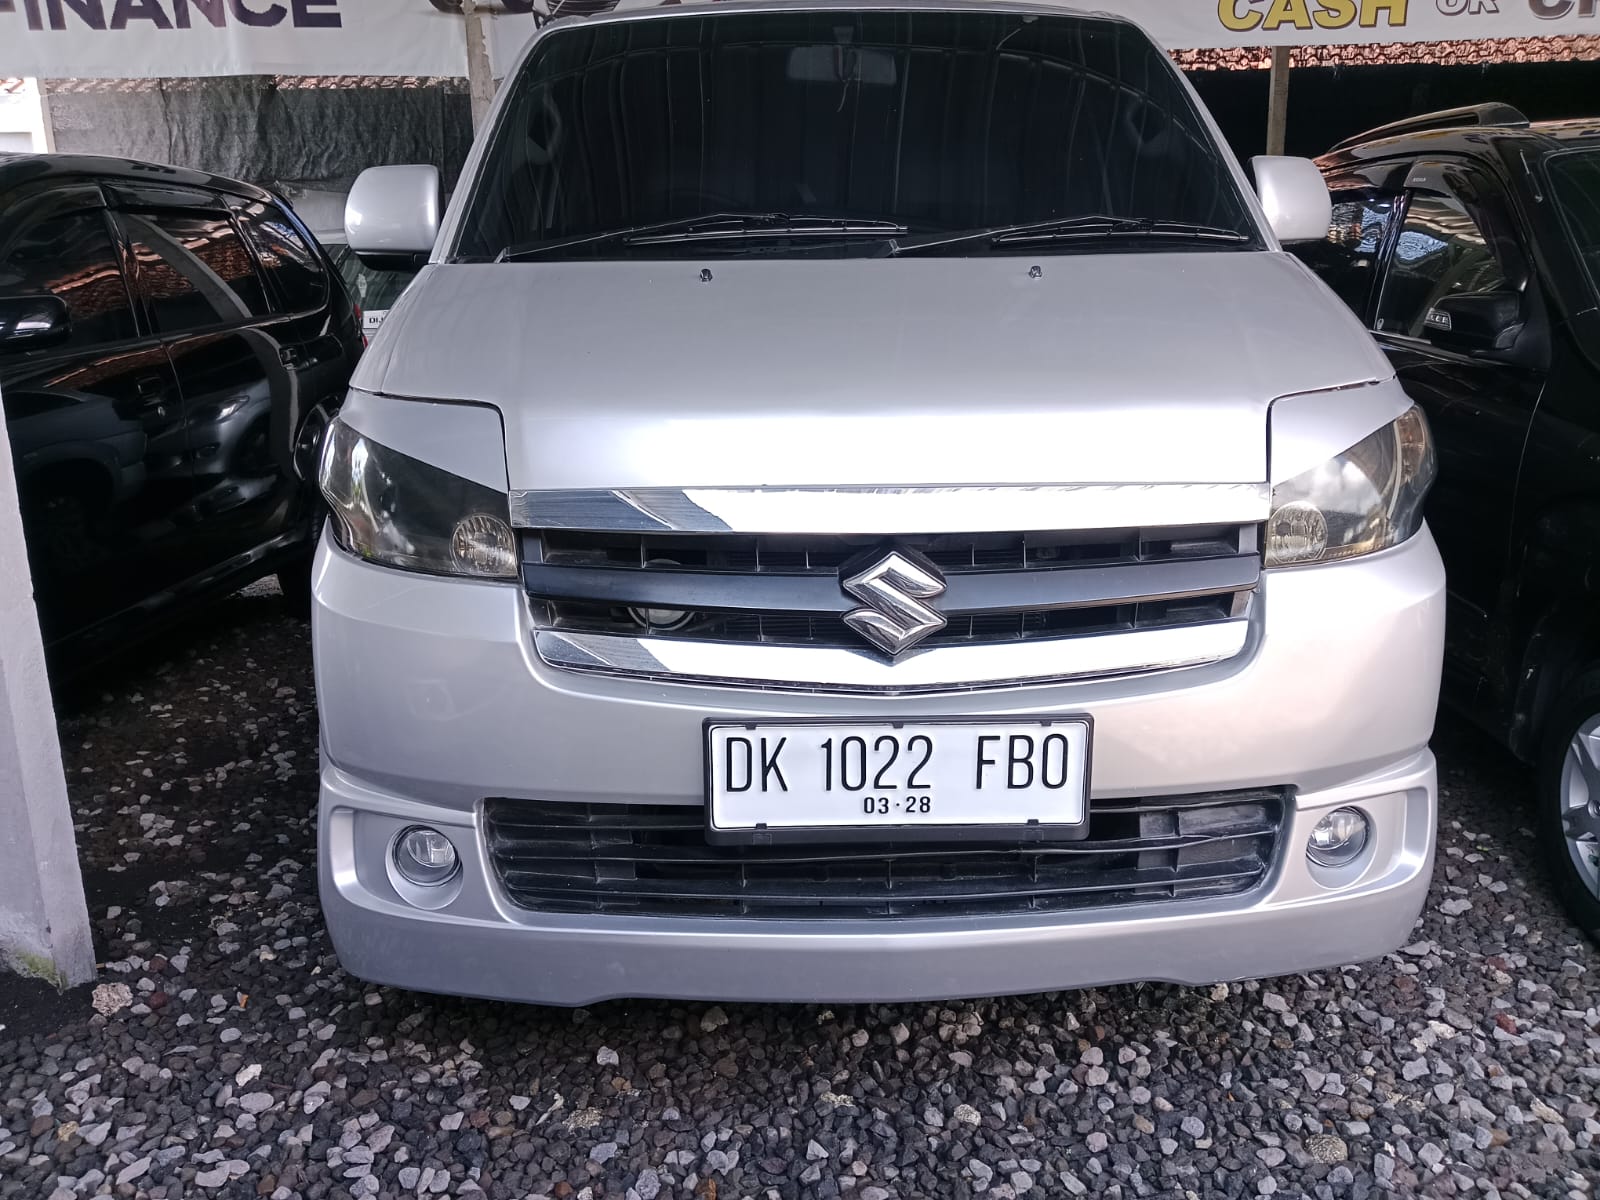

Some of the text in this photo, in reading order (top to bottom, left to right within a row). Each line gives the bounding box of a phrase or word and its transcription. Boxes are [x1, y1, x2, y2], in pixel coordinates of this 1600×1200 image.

[1217, 0, 1409, 32] CASH
[725, 733, 1069, 793] DK 1022 FBO
